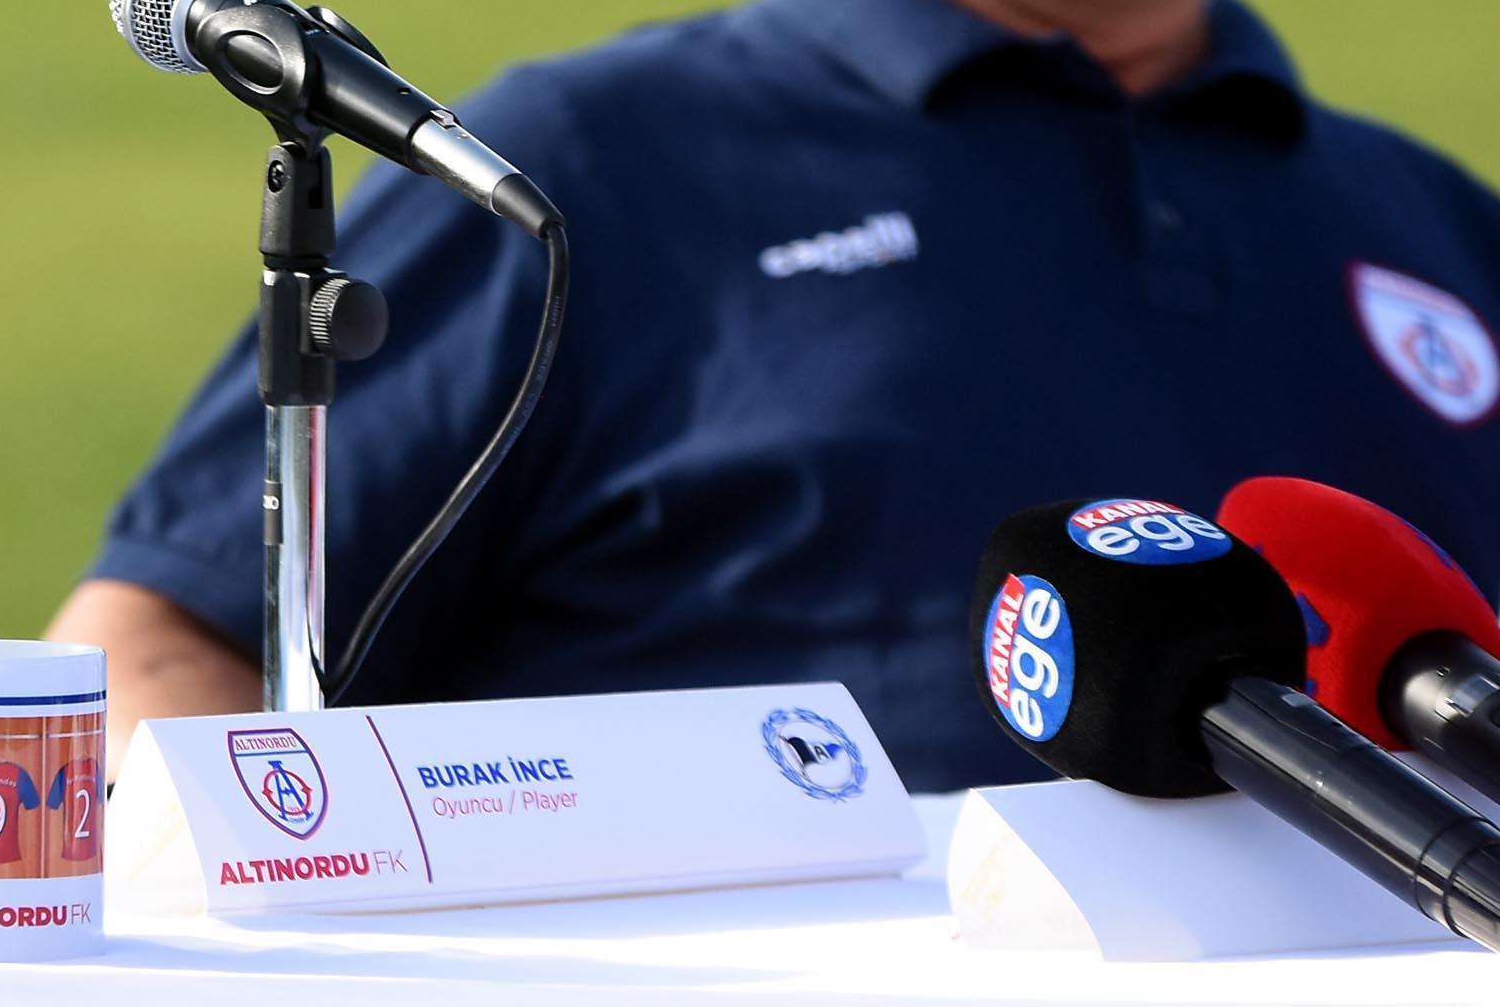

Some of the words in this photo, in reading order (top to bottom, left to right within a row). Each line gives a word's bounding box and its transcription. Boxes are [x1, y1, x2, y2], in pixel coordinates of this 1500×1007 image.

[1073, 501, 1185, 530] KANAL
[1087, 514, 1228, 556] ege
[990, 591, 1025, 704] KANAL
[1009, 588, 1061, 738] ege
[234, 736, 298, 751] ALTINORDU
[417, 761, 510, 789] BURAK
[507, 756, 575, 783] İNCE
[74, 789, 90, 838] 2
[432, 796, 503, 819] Oyuncu
[520, 791, 578, 813] Player
[220, 853, 370, 885] ALTINORDU
[373, 849, 410, 874] FK
[71, 902, 92, 925] FK
